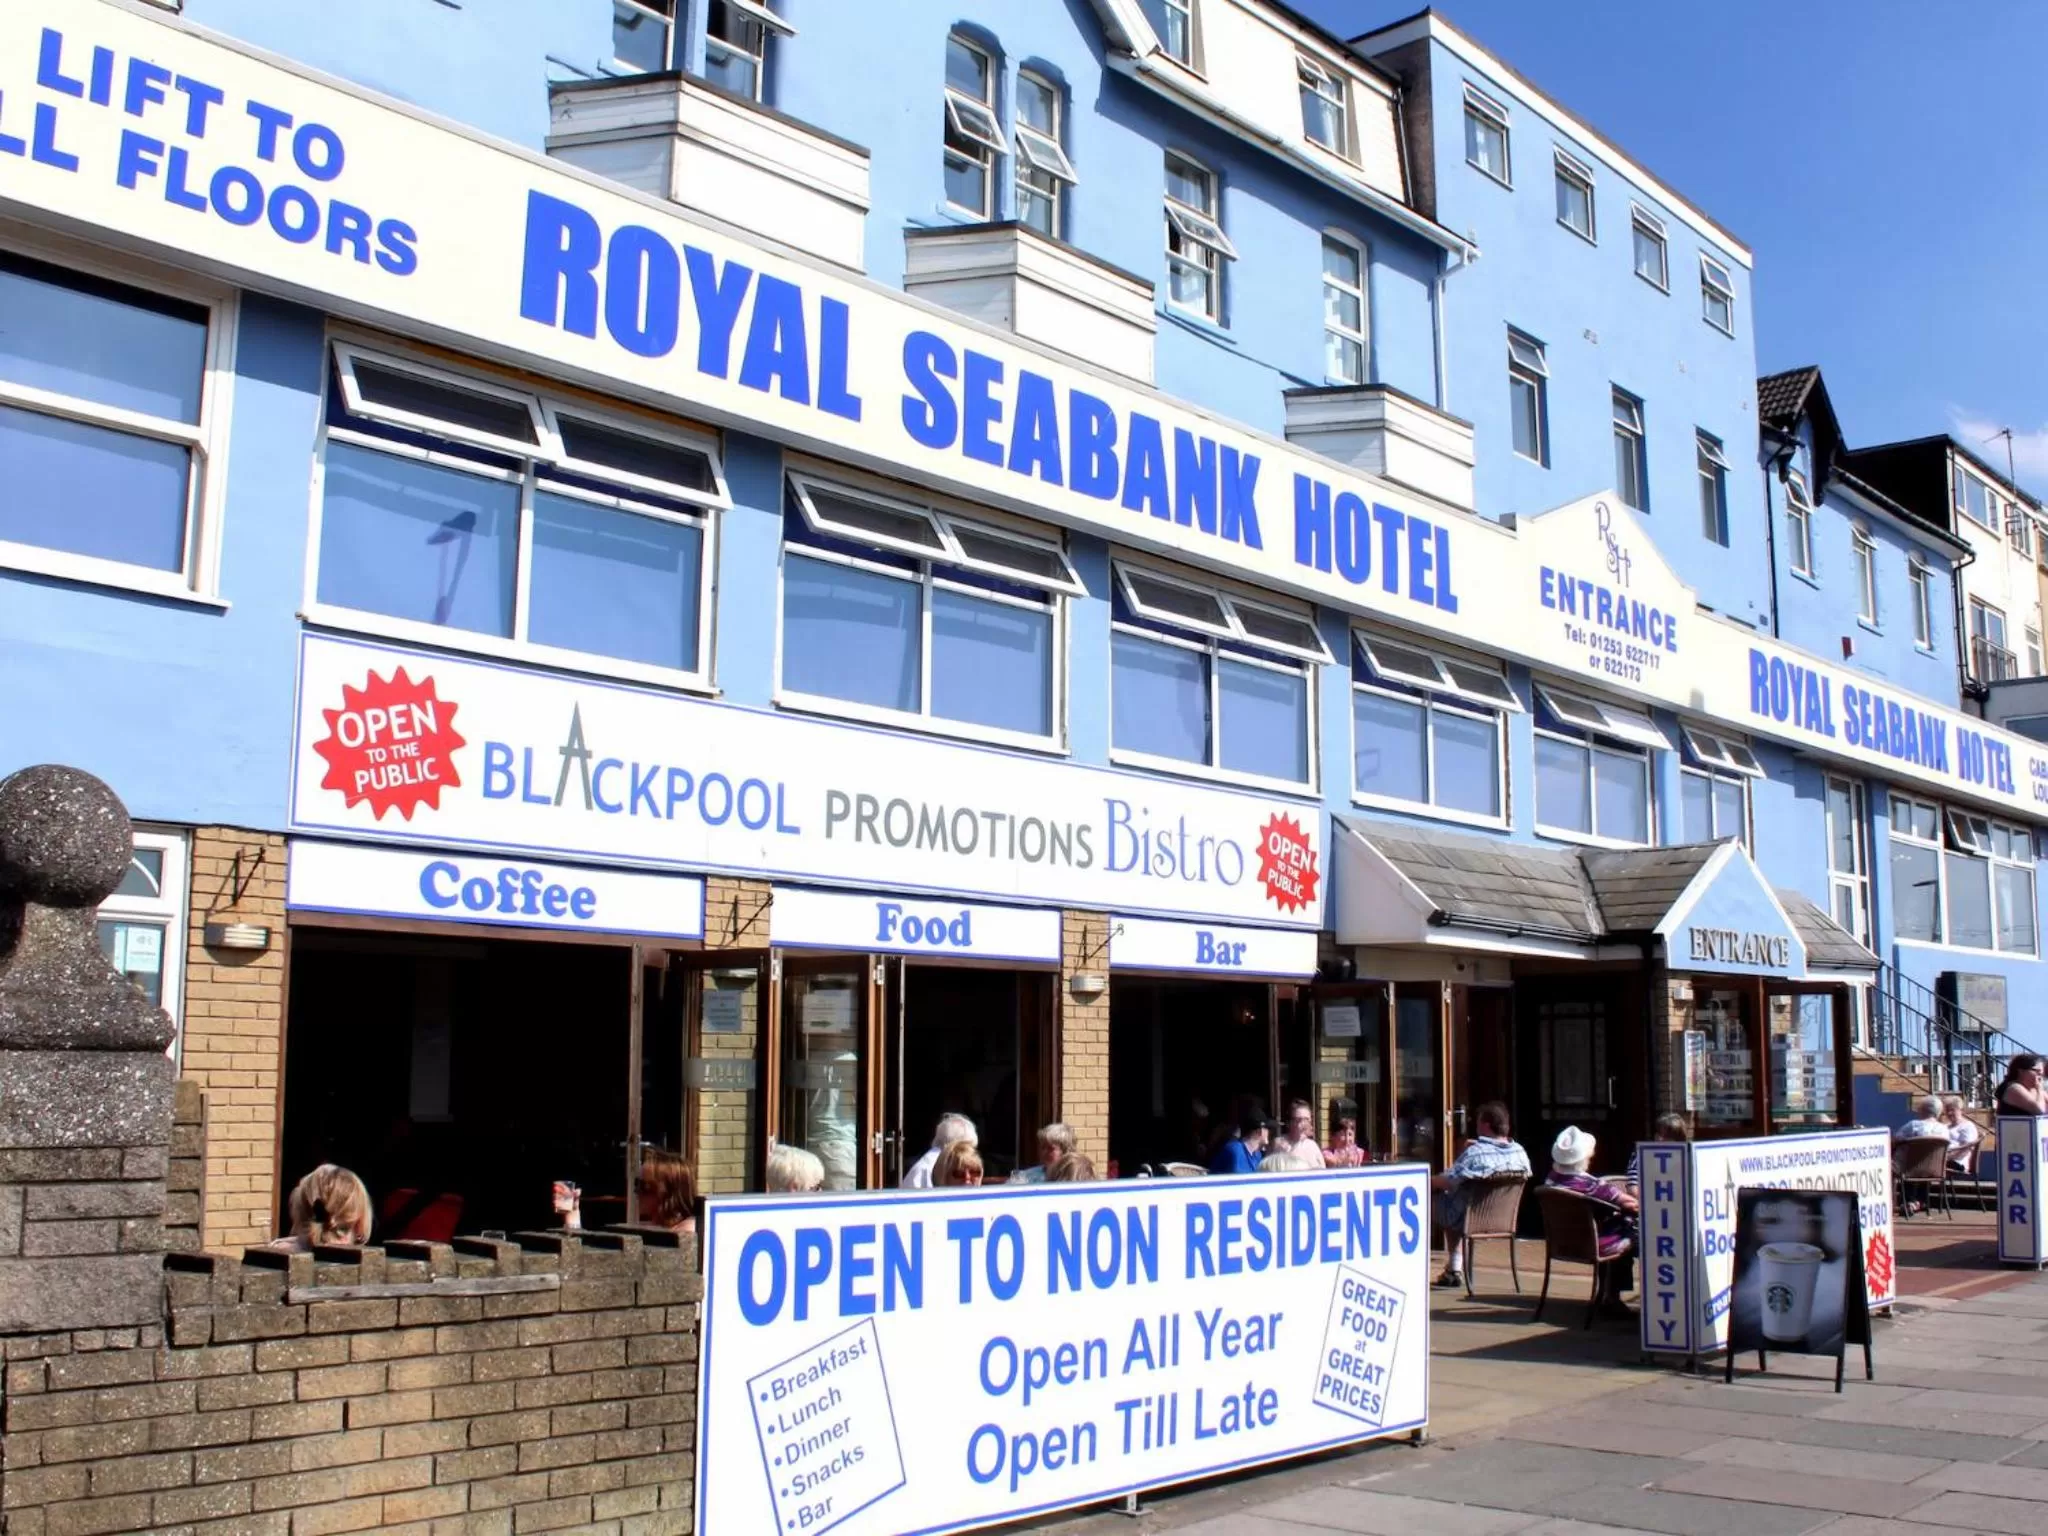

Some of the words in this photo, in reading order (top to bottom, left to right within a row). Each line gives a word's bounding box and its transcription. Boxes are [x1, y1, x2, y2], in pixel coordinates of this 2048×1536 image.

[37, 27, 224, 140] LIFT
[247, 100, 345, 182] TO
[116, 128, 418, 276] FLOORS
[520, 188, 863, 422] ROYAL
[902, 330, 1263, 552] SEABANK
[1294, 472, 1458, 614] HOTEL
[1540, 565, 1677, 653] ENTRANCE
[1564, 622, 1587, 645] Tel:
[1590, 632, 1622, 657] 01253
[1589, 654, 1601, 669] or
[1604, 657, 1641, 682] 622173
[336, 699, 438, 748] OPEN
[1749, 647, 1836, 737] ROYAL
[1843, 683, 1949, 774] SEABANK
[1957, 727, 2016, 796] HOTEL
[354, 757, 440, 793] PUBLIC
[365, 747, 387, 764] TO
[390, 742, 421, 760] THE
[482, 700, 801, 835] BLACKPOOL
[825, 788, 1094, 869] PROMOTIONS
[1103, 797, 1244, 886] Bistro
[1268, 831, 1312, 874] OPEN
[419, 860, 597, 920] Coffee
[1268, 867, 1304, 900] PUBLIC
[875, 902, 973, 947] Food
[1195, 930, 1247, 966] Bar
[1688, 927, 1790, 968] ENTRANCE
[2007, 1153, 2028, 1225] BAR
[736, 1219, 925, 1327] OPEN
[947, 1214, 1026, 1304] TO
[1047, 1205, 1159, 1295] NON
[1185, 1185, 1420, 1280] RESIDENTS
[1653, 1152, 1676, 1343] THIRSTY
[1342, 1278, 1398, 1318] GREAT
[1341, 1306, 1387, 1342] FOOD
[1354, 1340, 1367, 1354] at
[771, 1336, 868, 1402] Breakfast
[979, 1336, 1108, 1406] Open
[1123, 1312, 1181, 1375] All
[1195, 1306, 1284, 1359] Year
[1328, 1348, 1385, 1387] GREAT
[778, 1386, 843, 1434] Lunch
[1320, 1373, 1382, 1415] PRICES
[784, 1416, 852, 1466] Dinner
[966, 1421, 1098, 1493] Open
[1115, 1392, 1178, 1454] Till
[1195, 1382, 1280, 1439] Late
[791, 1445, 865, 1496] Snacks
[798, 1496, 834, 1529] Bar
